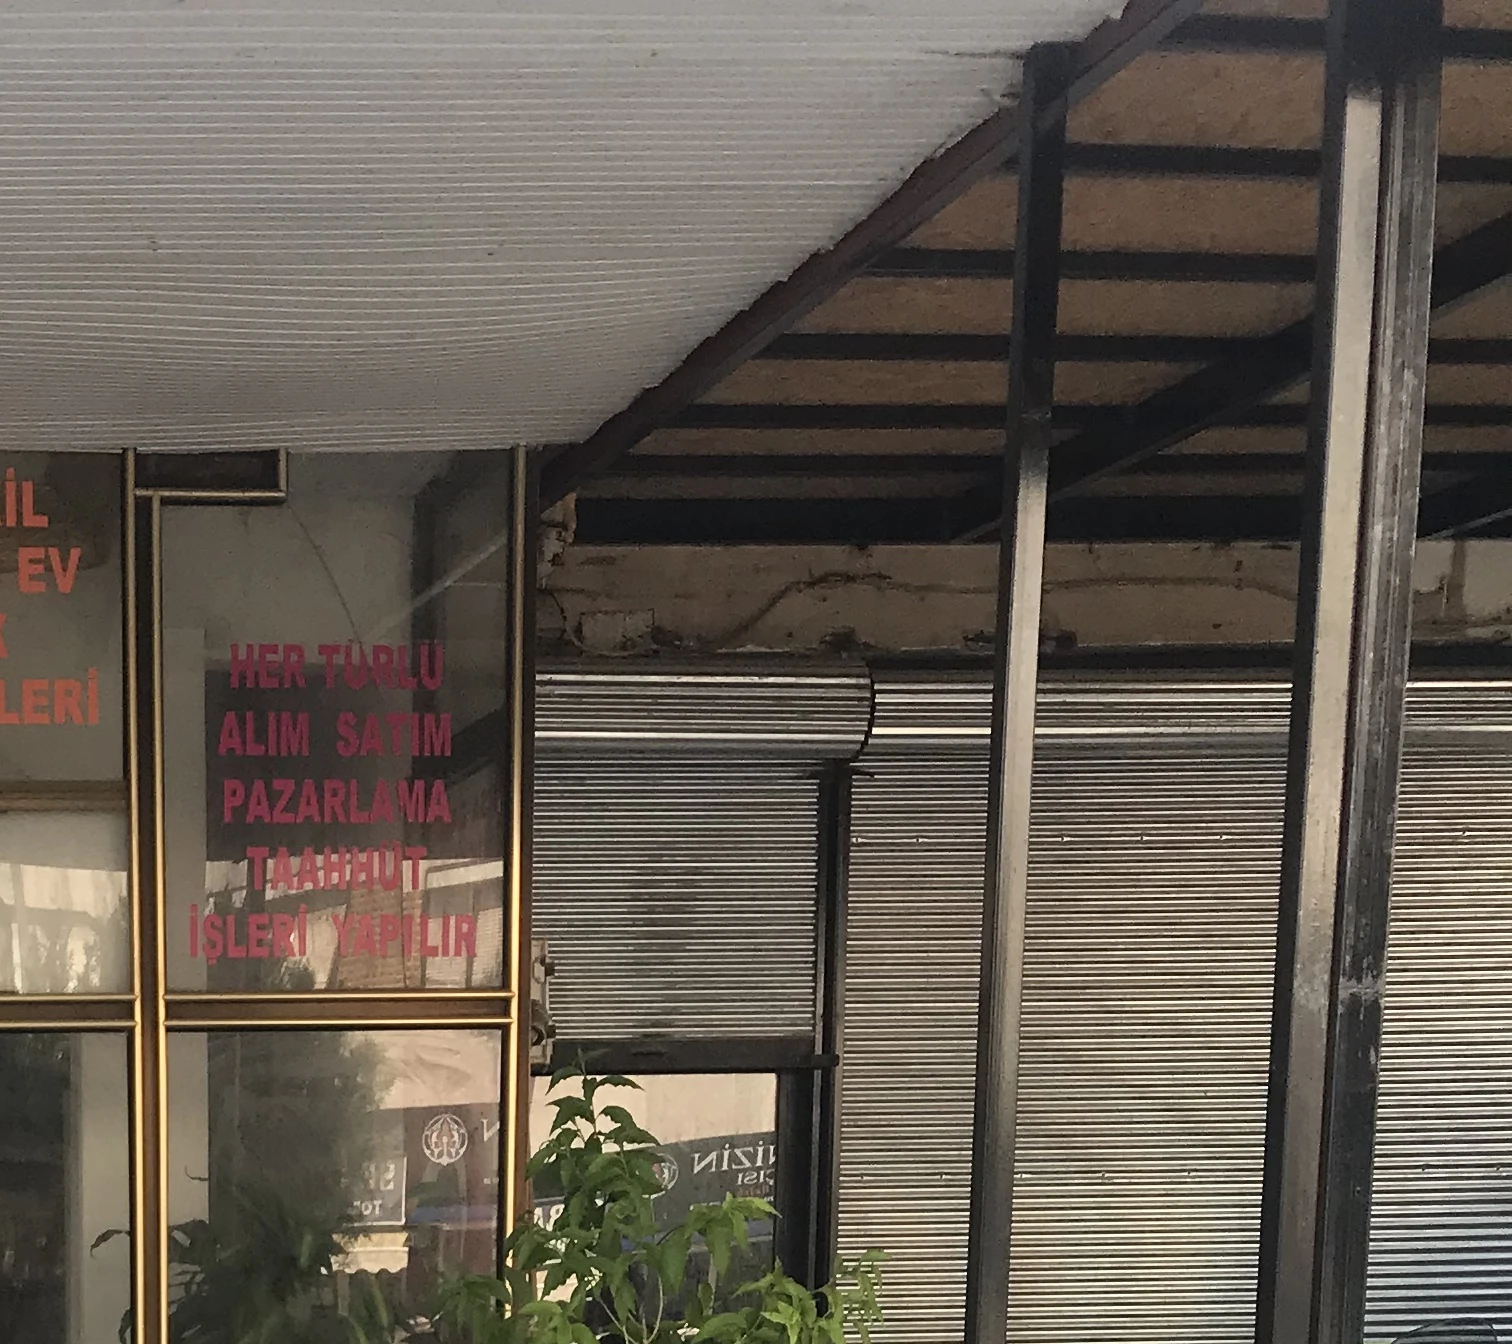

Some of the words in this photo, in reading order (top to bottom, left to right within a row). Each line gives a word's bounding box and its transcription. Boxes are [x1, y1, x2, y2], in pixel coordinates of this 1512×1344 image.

[17, 545, 81, 594] EV
[229, 643, 307, 690] HER
[217, 711, 311, 757] ALIM
[335, 711, 453, 757] SATIM
[222, 778, 453, 825] PAZARLAMA
[245, 839, 428, 892] TAAHHÜT
[189, 903, 309, 967] İŞLERİ
[330, 912, 479, 959] YAPILIR
